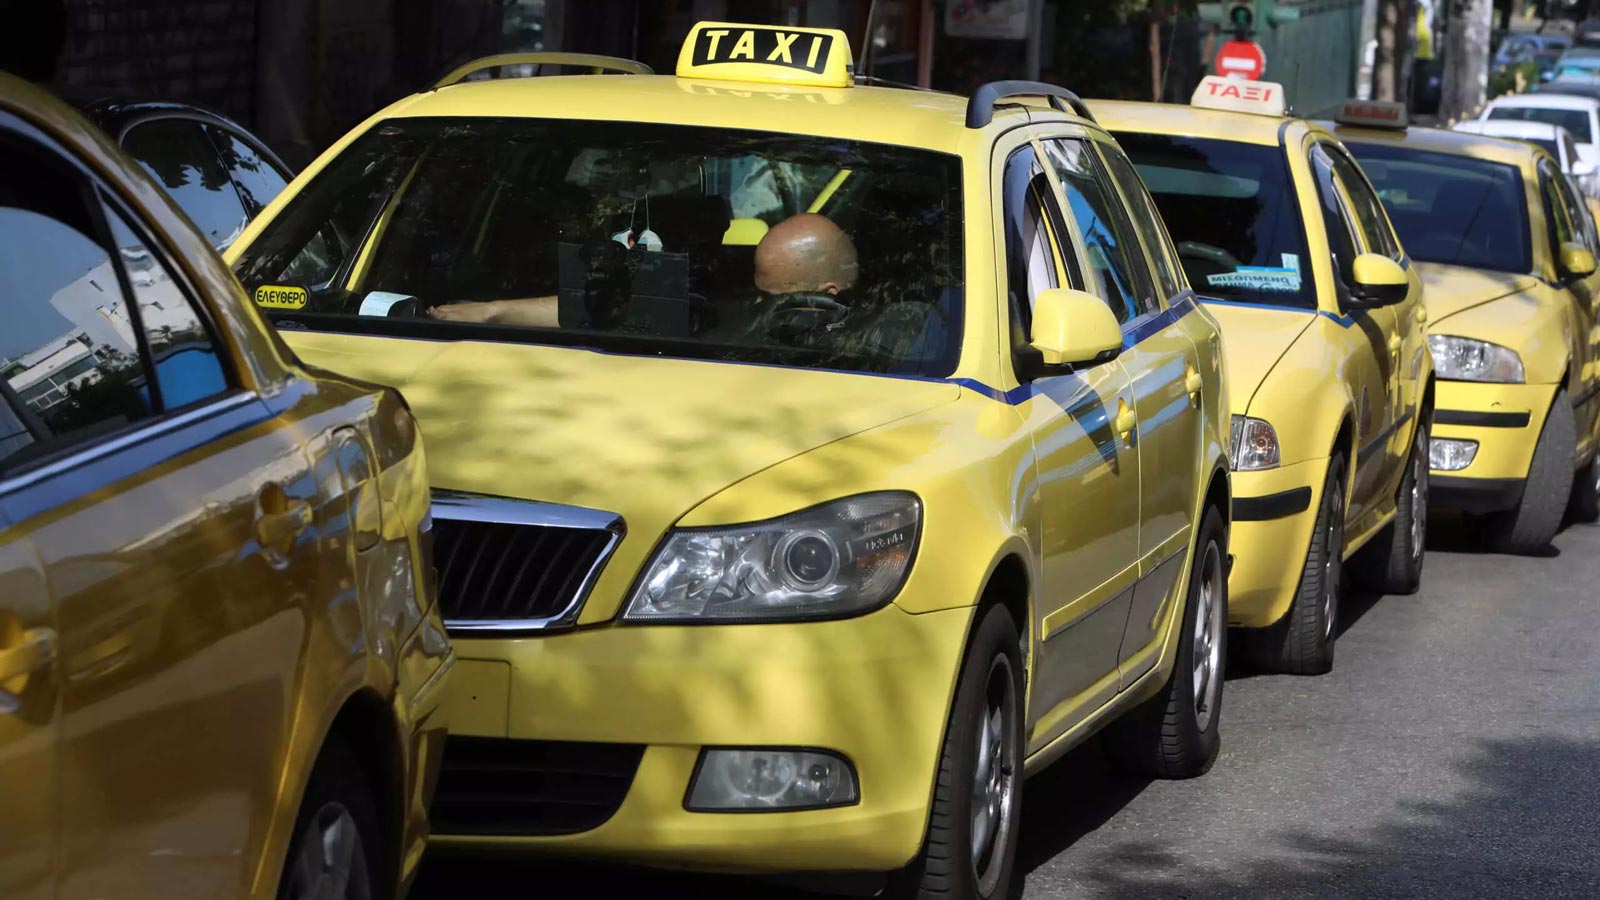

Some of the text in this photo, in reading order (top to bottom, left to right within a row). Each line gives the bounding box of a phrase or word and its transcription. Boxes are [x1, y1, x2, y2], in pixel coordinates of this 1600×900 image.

[706, 30, 824, 68] TAXI
[1207, 82, 1271, 102] ΤΑΞΙ
[256, 290, 306, 305] ΕΛΕΥΘΕΡΟ
